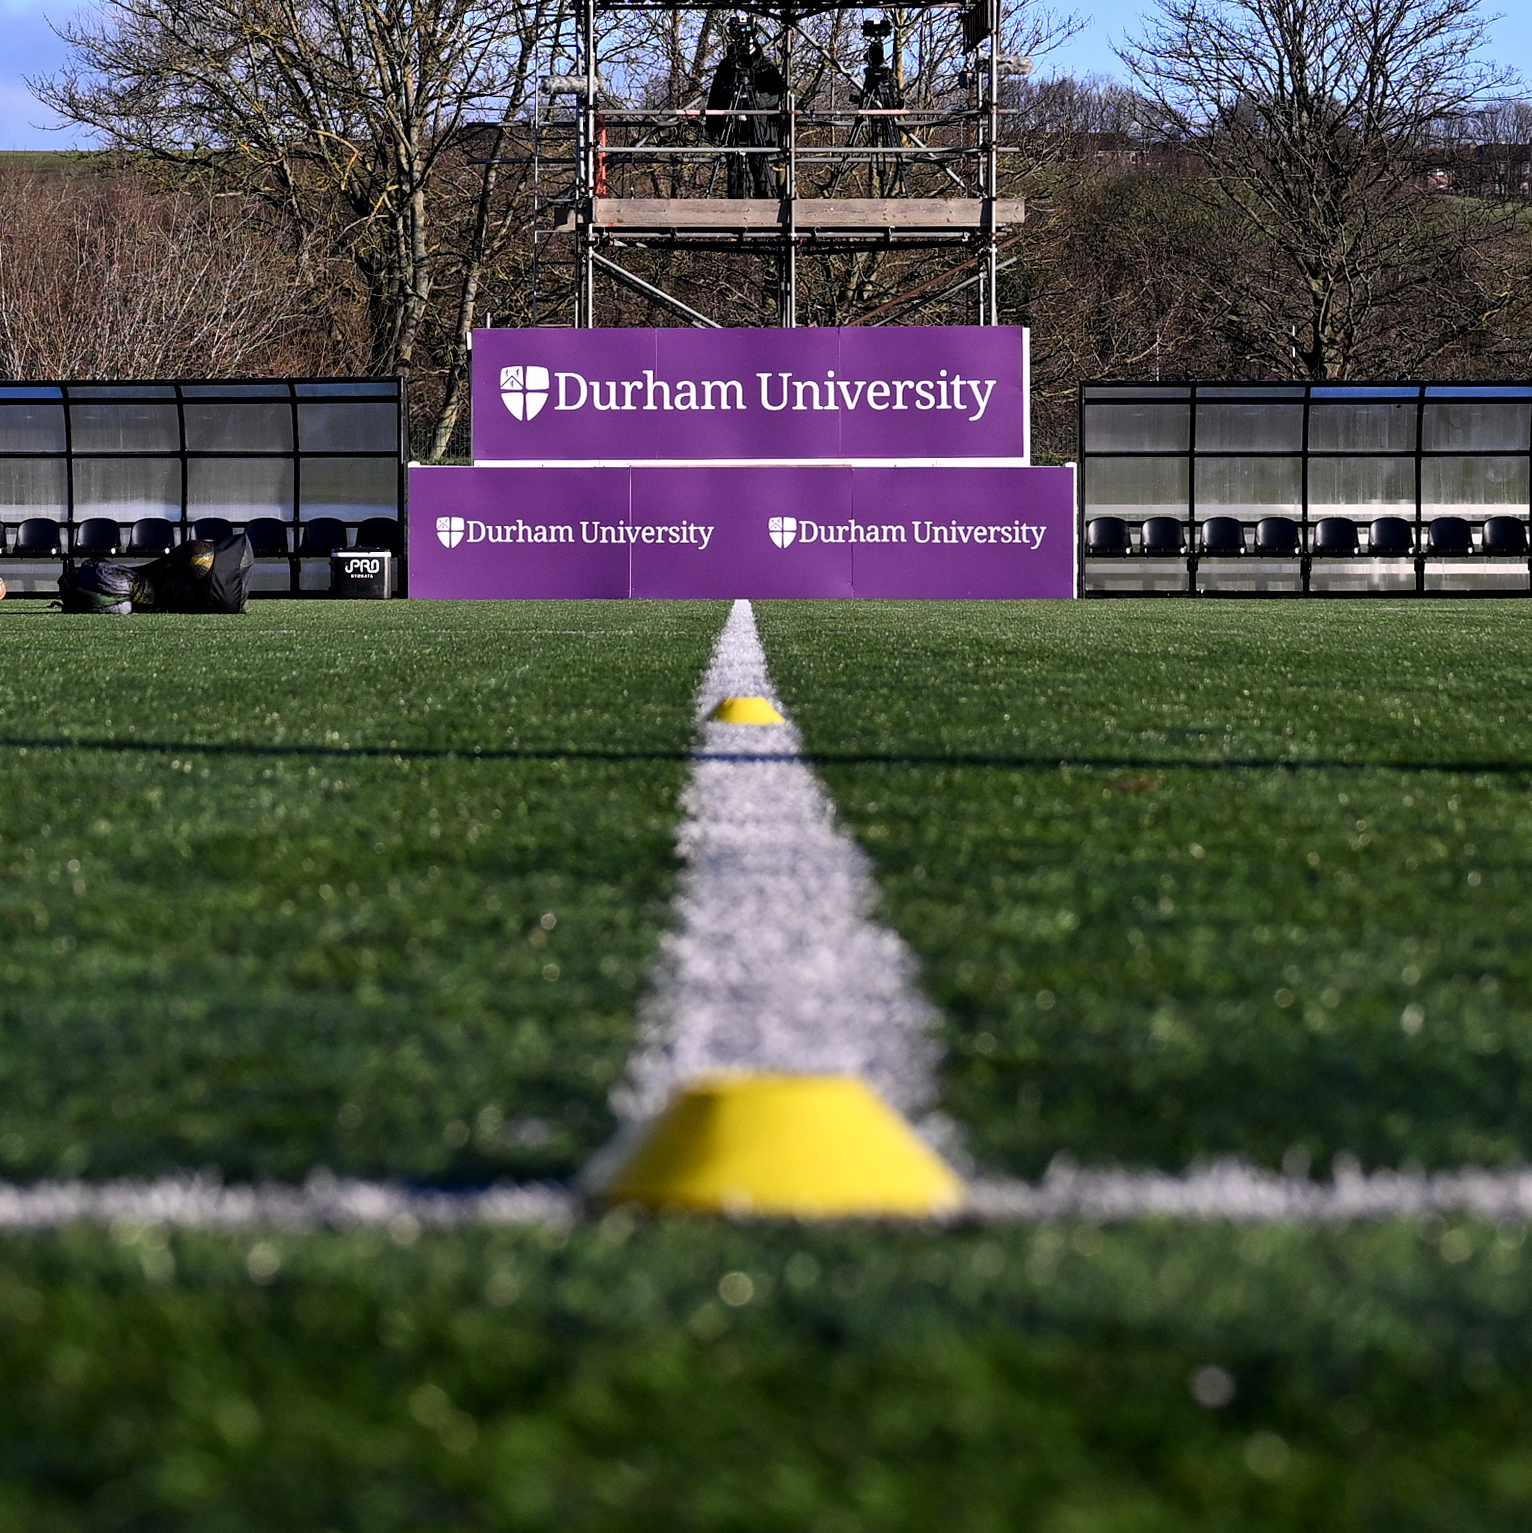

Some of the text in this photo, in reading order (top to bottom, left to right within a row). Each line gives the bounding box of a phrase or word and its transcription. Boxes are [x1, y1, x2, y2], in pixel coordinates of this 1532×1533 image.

[554, 370, 997, 422] Durham University
[467, 520, 715, 549] Durham University
[798, 520, 1047, 549] Durham University
